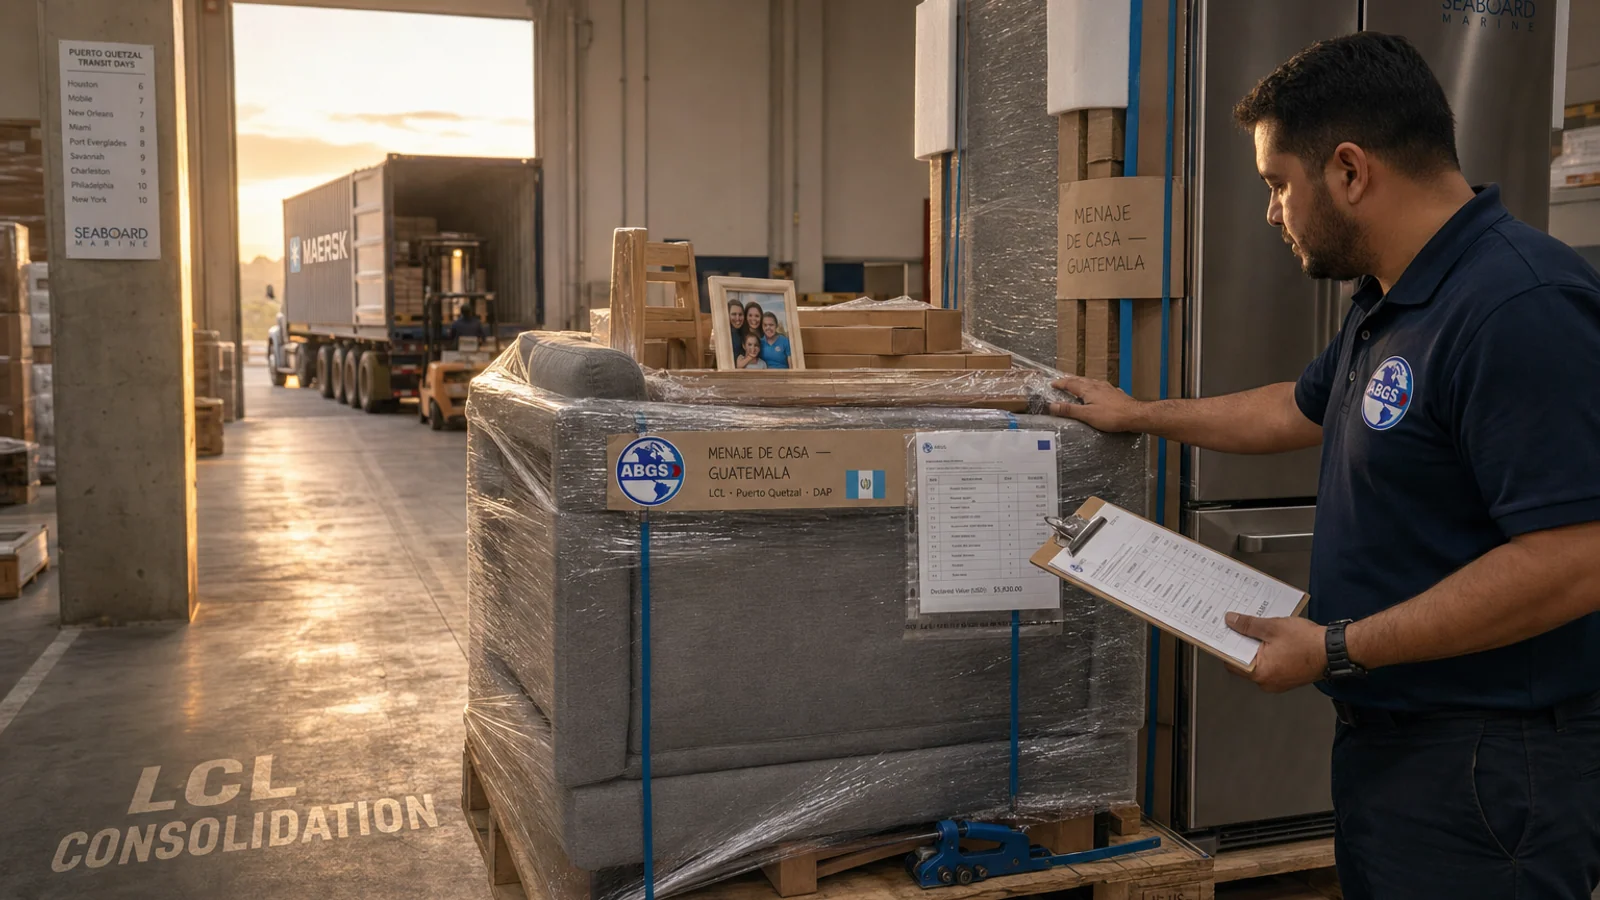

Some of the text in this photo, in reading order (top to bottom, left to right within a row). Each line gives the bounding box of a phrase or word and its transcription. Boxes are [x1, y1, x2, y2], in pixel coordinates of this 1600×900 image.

[1442, 0, 1535, 18] SEABOARD
[1442, 13, 1535, 32] MARINE
[68, 48, 143, 59] PUERTO QUETZAL
[78, 58, 135, 69] TRANSIT DAYS
[67, 80, 144, 90] Houston 6
[67, 94, 144, 105] Mobile 7
[86, 109, 114, 118] Orleans
[139, 111, 144, 119] 7
[68, 123, 145, 133] Miami 8
[69, 138, 145, 148] Port Everglades 8
[70, 152, 146, 162] Savannah 9
[70, 166, 146, 176] Charleston 9
[71, 181, 147, 191] Philadelphia 10
[90, 196, 107, 204] York
[138, 196, 148, 204] 10
[1074, 204, 1131, 224] MENAJE
[74, 226, 148, 240] SEABOARD
[75, 240, 148, 248] MARINE
[1066, 233, 1081, 250] DE
[1086, 231, 1121, 248] CASA
[302, 230, 348, 265] MAERSK
[1067, 254, 1145, 275] GUATEMALA
[1366, 381, 1399, 403] ABGS
[708, 446, 753, 460] MENAJE
[758, 446, 773, 459] DE
[777, 446, 810, 459] CASA
[620, 463, 669, 478] ABGS
[708, 466, 791, 480] GUATEMALA
[709, 488, 726, 498] LCL
[736, 488, 766, 498] Puerto
[767, 488, 802, 499] Quetzal
[813, 487, 833, 497] DAP
[126, 753, 297, 816] LCL
[50, 793, 439, 874] CONSOLIDATION
